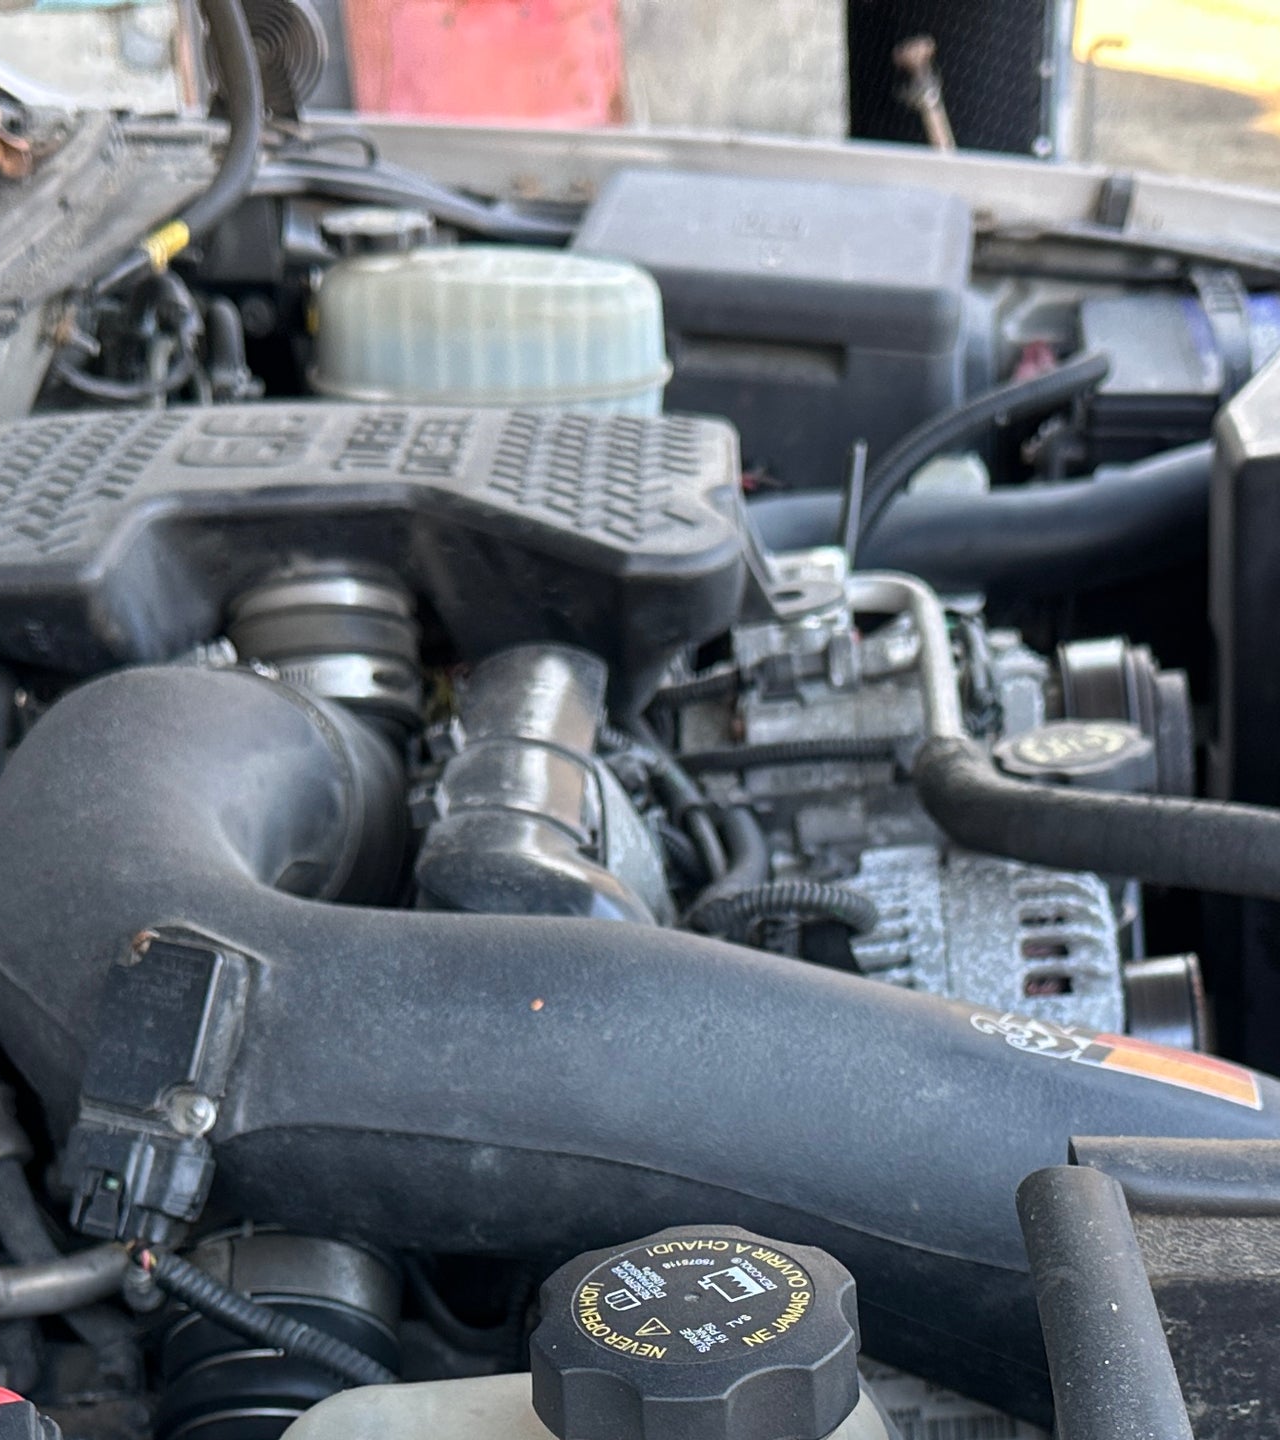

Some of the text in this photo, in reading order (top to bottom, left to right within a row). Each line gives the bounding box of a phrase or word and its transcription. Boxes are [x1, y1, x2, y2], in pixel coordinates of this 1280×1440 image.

[645, 1240, 729, 1257] CHAUD!
[751, 1247, 808, 1288] OUVRIR
[579, 1282, 668, 1359] NEVER OPEN HOT!
[726, 1314, 752, 1328] TVS
[772, 1291, 811, 1333] JAMAIS
[679, 1327, 711, 1353] SURGE
[692, 1326, 718, 1347] TANK
[702, 1322, 729, 1344] 15 PSI
[742, 1328, 777, 1347] NE
